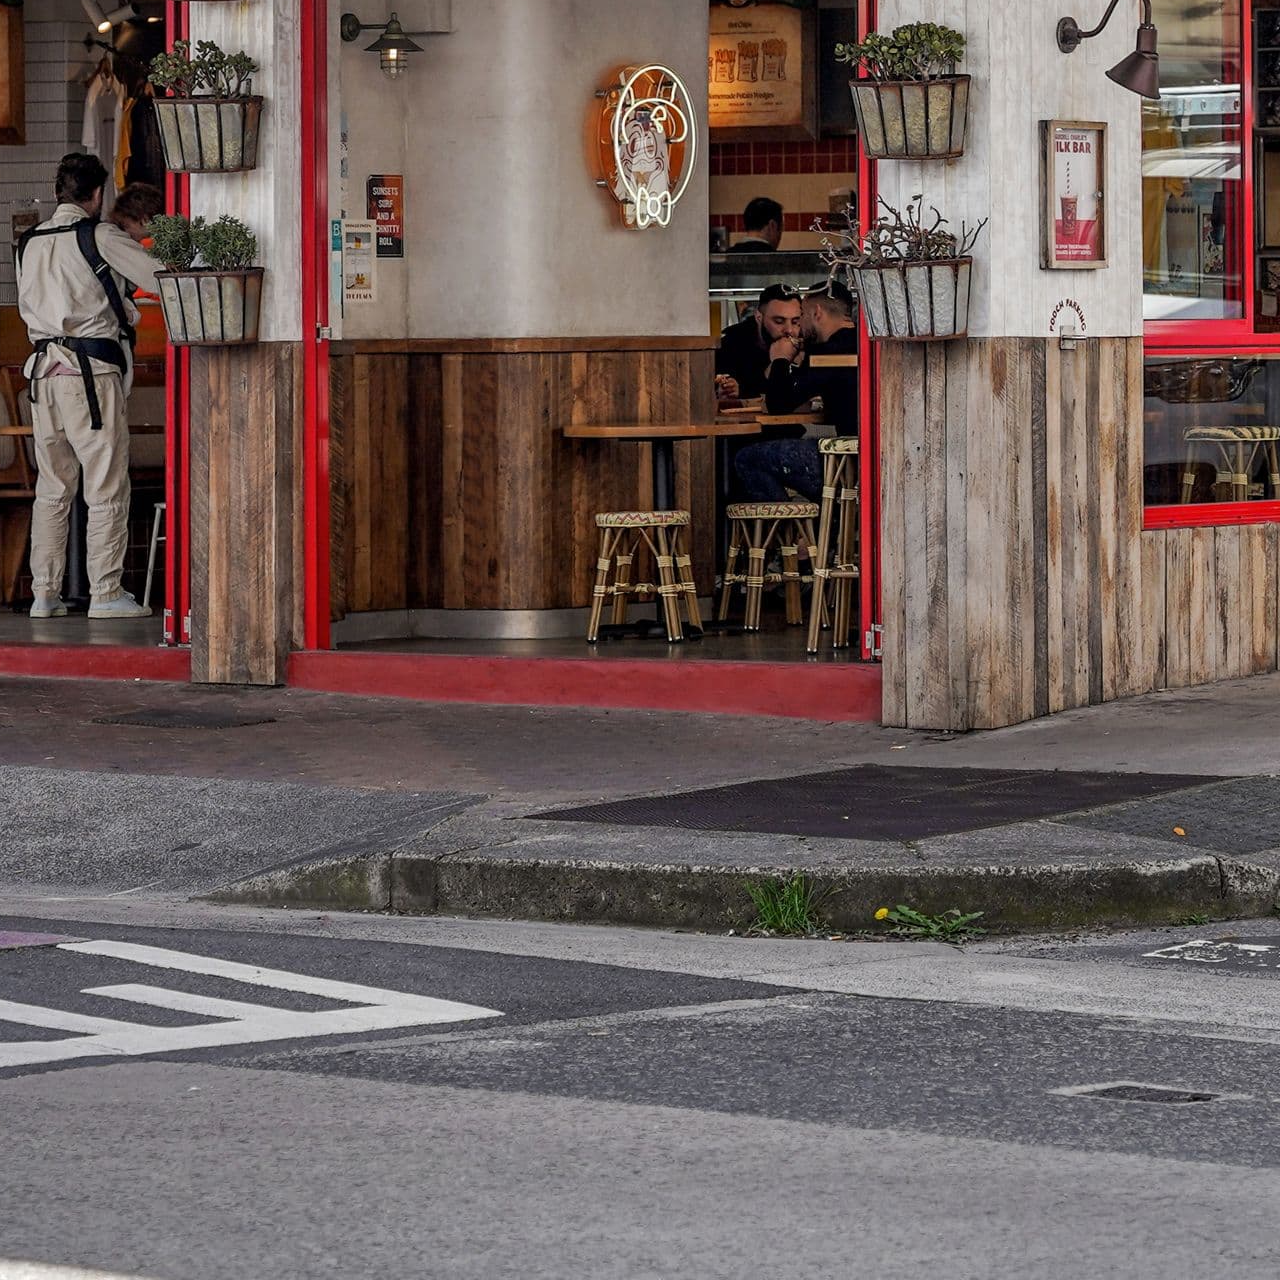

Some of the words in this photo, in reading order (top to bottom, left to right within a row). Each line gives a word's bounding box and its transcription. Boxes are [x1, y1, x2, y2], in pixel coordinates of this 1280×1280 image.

[1056, 141, 1071, 153] ILK
[1072, 141, 1092, 154] BAR
[372, 187, 399, 196] SUNSETS
[378, 200, 394, 208] SURF
[376, 212, 390, 221] AND
[390, 212, 396, 221] A
[379, 237, 393, 246] ROLL
[1049, 300, 1065, 332] POOCH
[1066, 298, 1087, 332] PARKING
